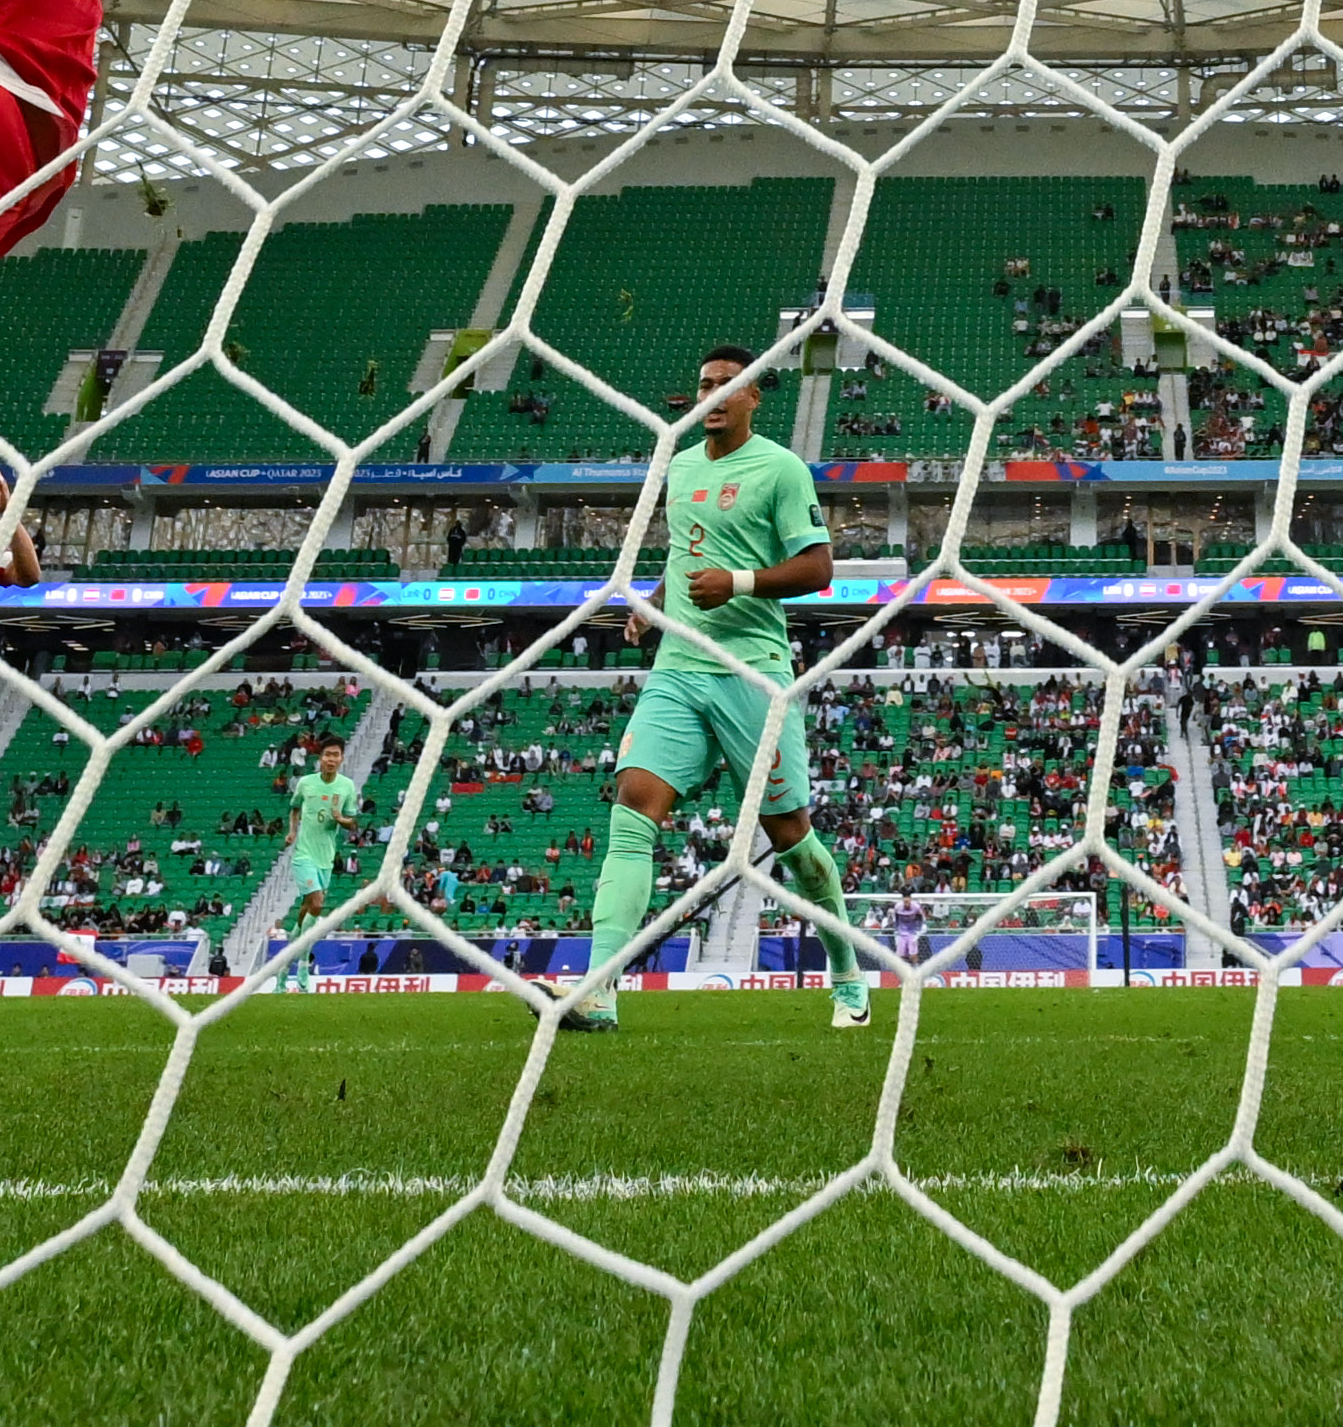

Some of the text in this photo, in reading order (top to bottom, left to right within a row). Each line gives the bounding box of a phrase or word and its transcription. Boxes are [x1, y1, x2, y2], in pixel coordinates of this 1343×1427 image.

[689, 523, 706, 557] 2
[317, 808, 326, 823] 6
[315, 976, 431, 993] 中国伊利
